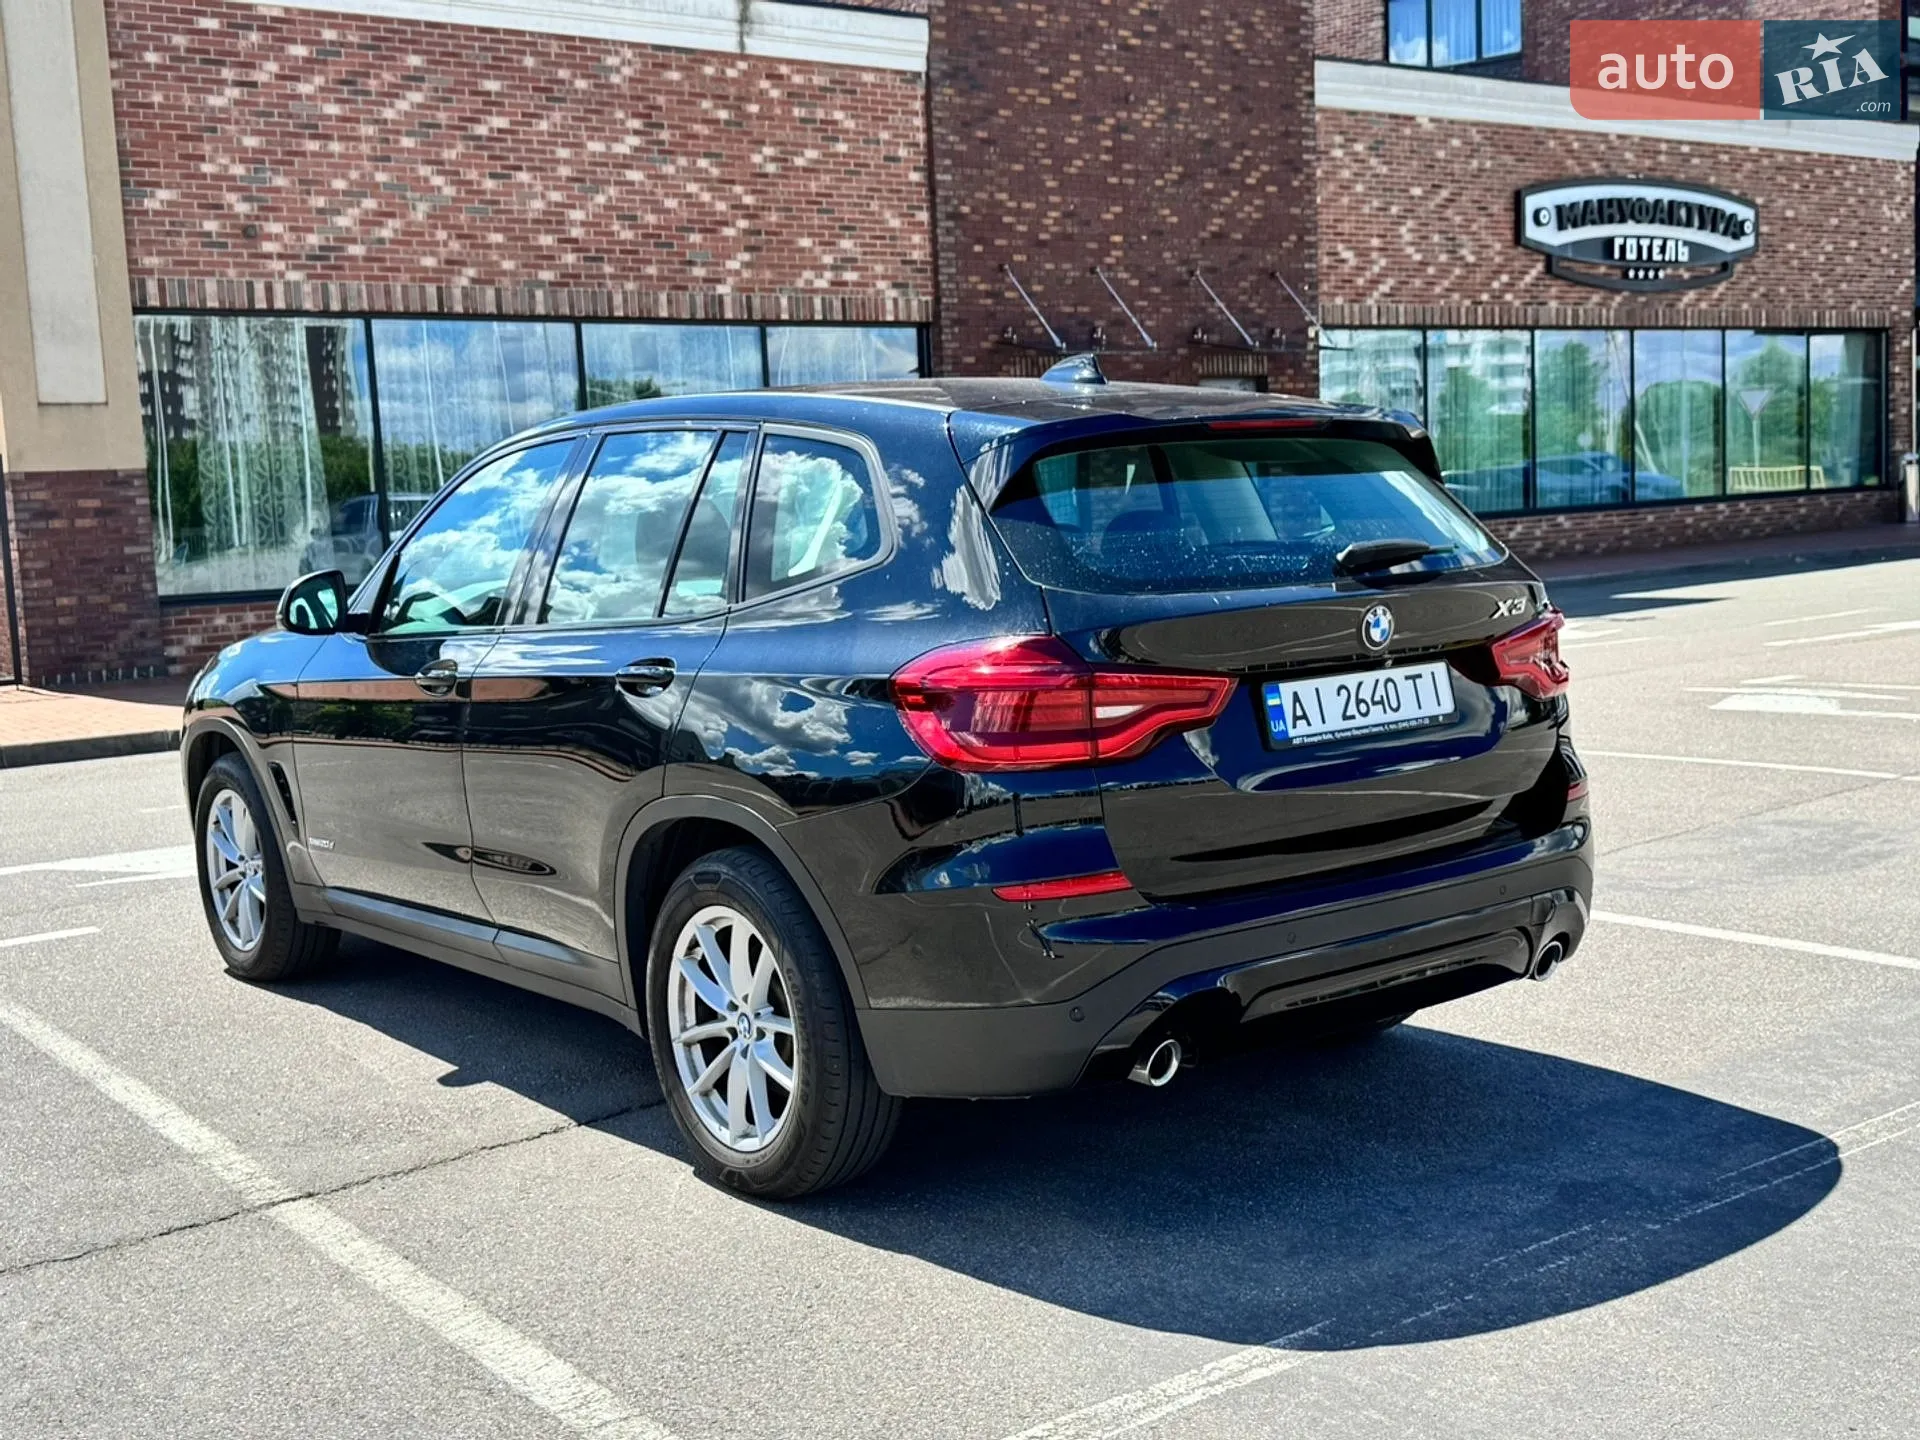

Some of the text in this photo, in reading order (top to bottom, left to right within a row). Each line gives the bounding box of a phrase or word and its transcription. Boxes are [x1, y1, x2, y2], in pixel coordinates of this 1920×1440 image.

[1554, 197, 1742, 240] МАНУФАКТУРА
[1612, 236, 1690, 263] ГОТЕЛЬ
[1491, 596, 1528, 620] X3
[1336, 677, 1402, 722] 2640
[1404, 671, 1442, 711] TI
[1270, 719, 1287, 733] UA
